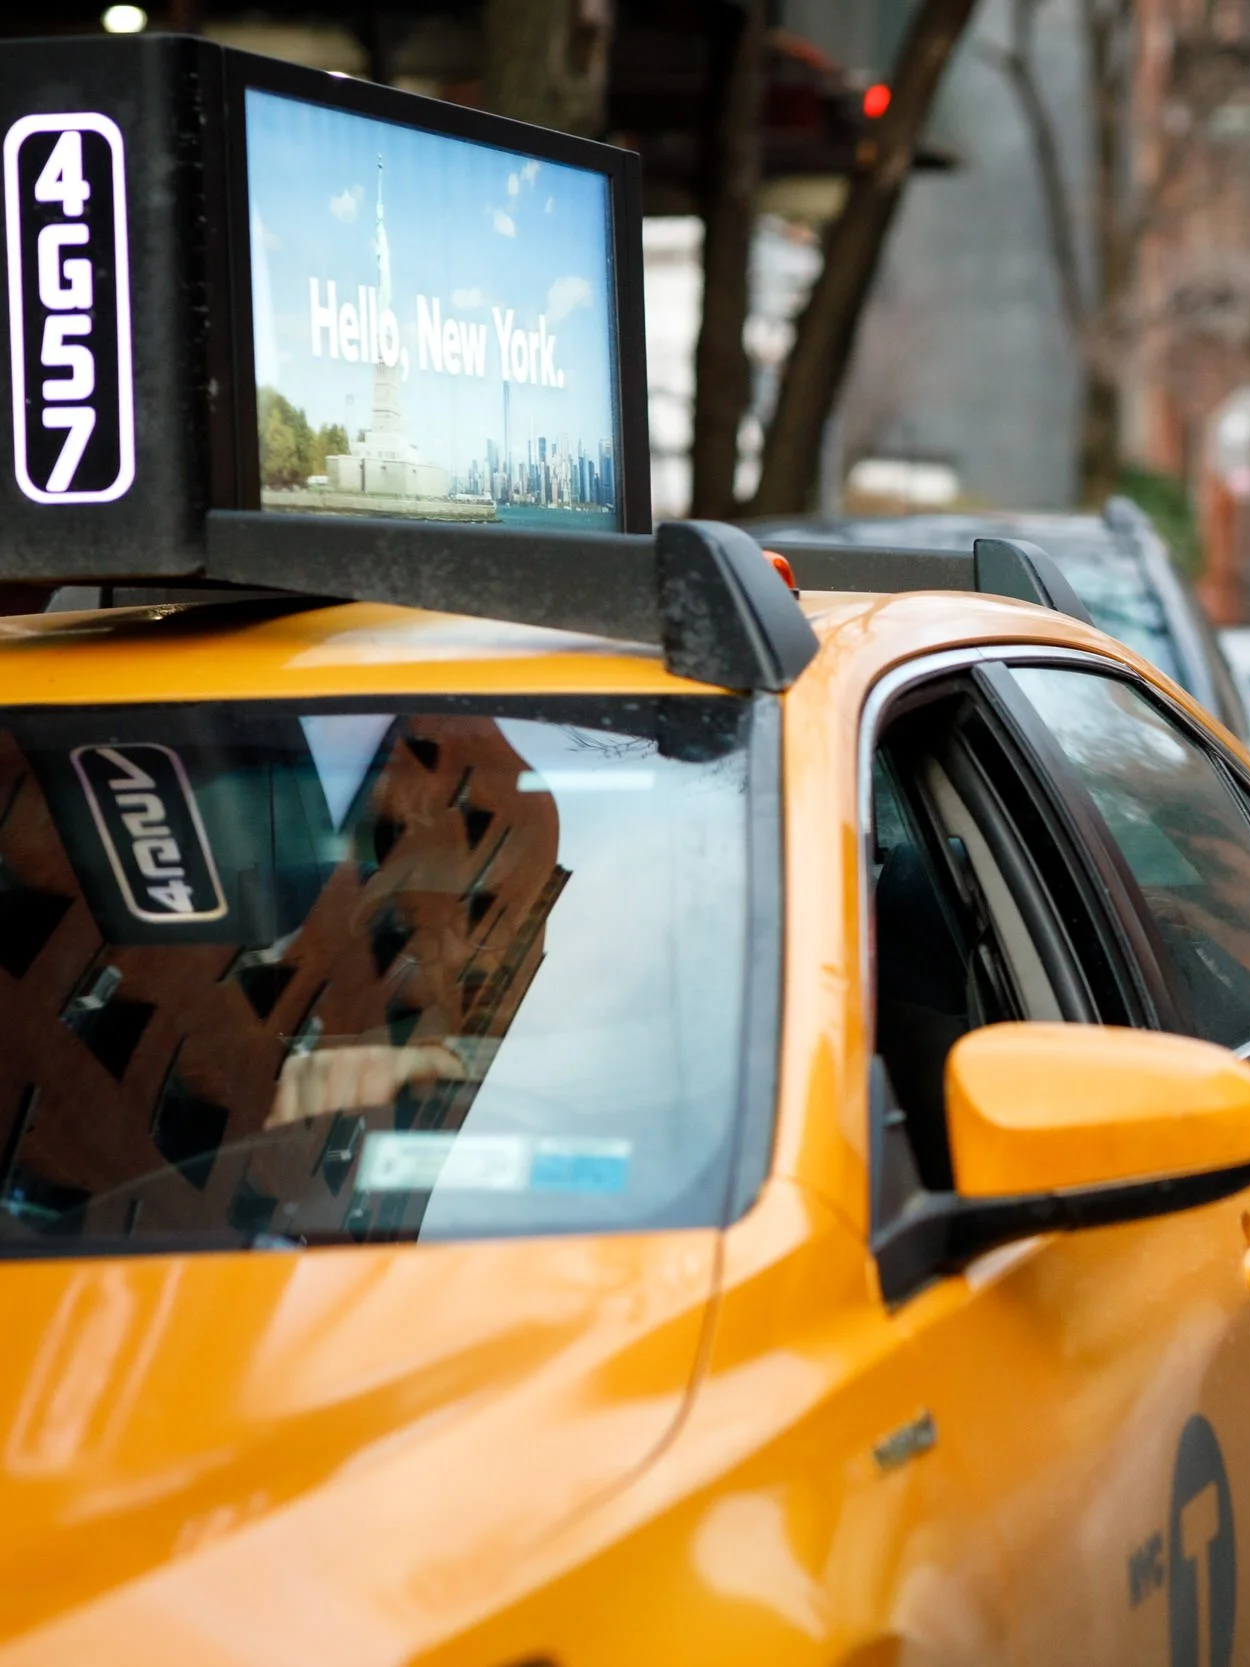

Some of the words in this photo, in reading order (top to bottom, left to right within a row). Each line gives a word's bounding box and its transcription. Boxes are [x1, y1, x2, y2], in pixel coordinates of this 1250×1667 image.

[34, 130, 96, 492] 4G57
[309, 277, 409, 381] Hello,
[416, 293, 486, 377] New
[491, 306, 564, 388] York.
